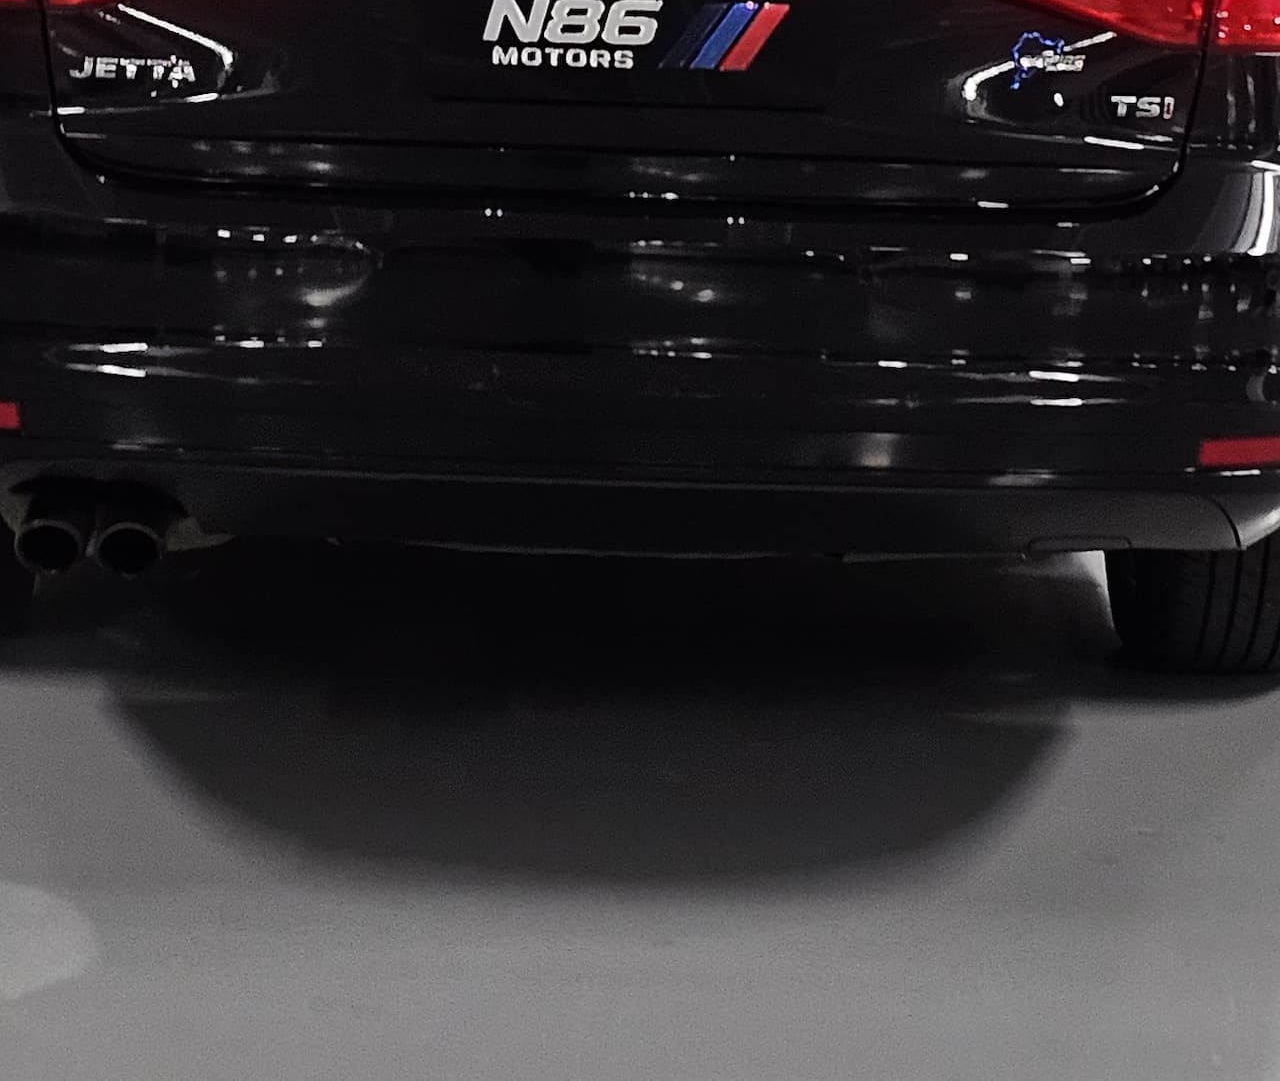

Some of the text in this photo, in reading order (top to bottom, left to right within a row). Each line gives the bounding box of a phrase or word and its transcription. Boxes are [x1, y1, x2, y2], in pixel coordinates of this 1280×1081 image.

[491, 44, 635, 69] MOTORS
[68, 55, 196, 84] JETTA
[1110, 95, 1176, 120] TSI
